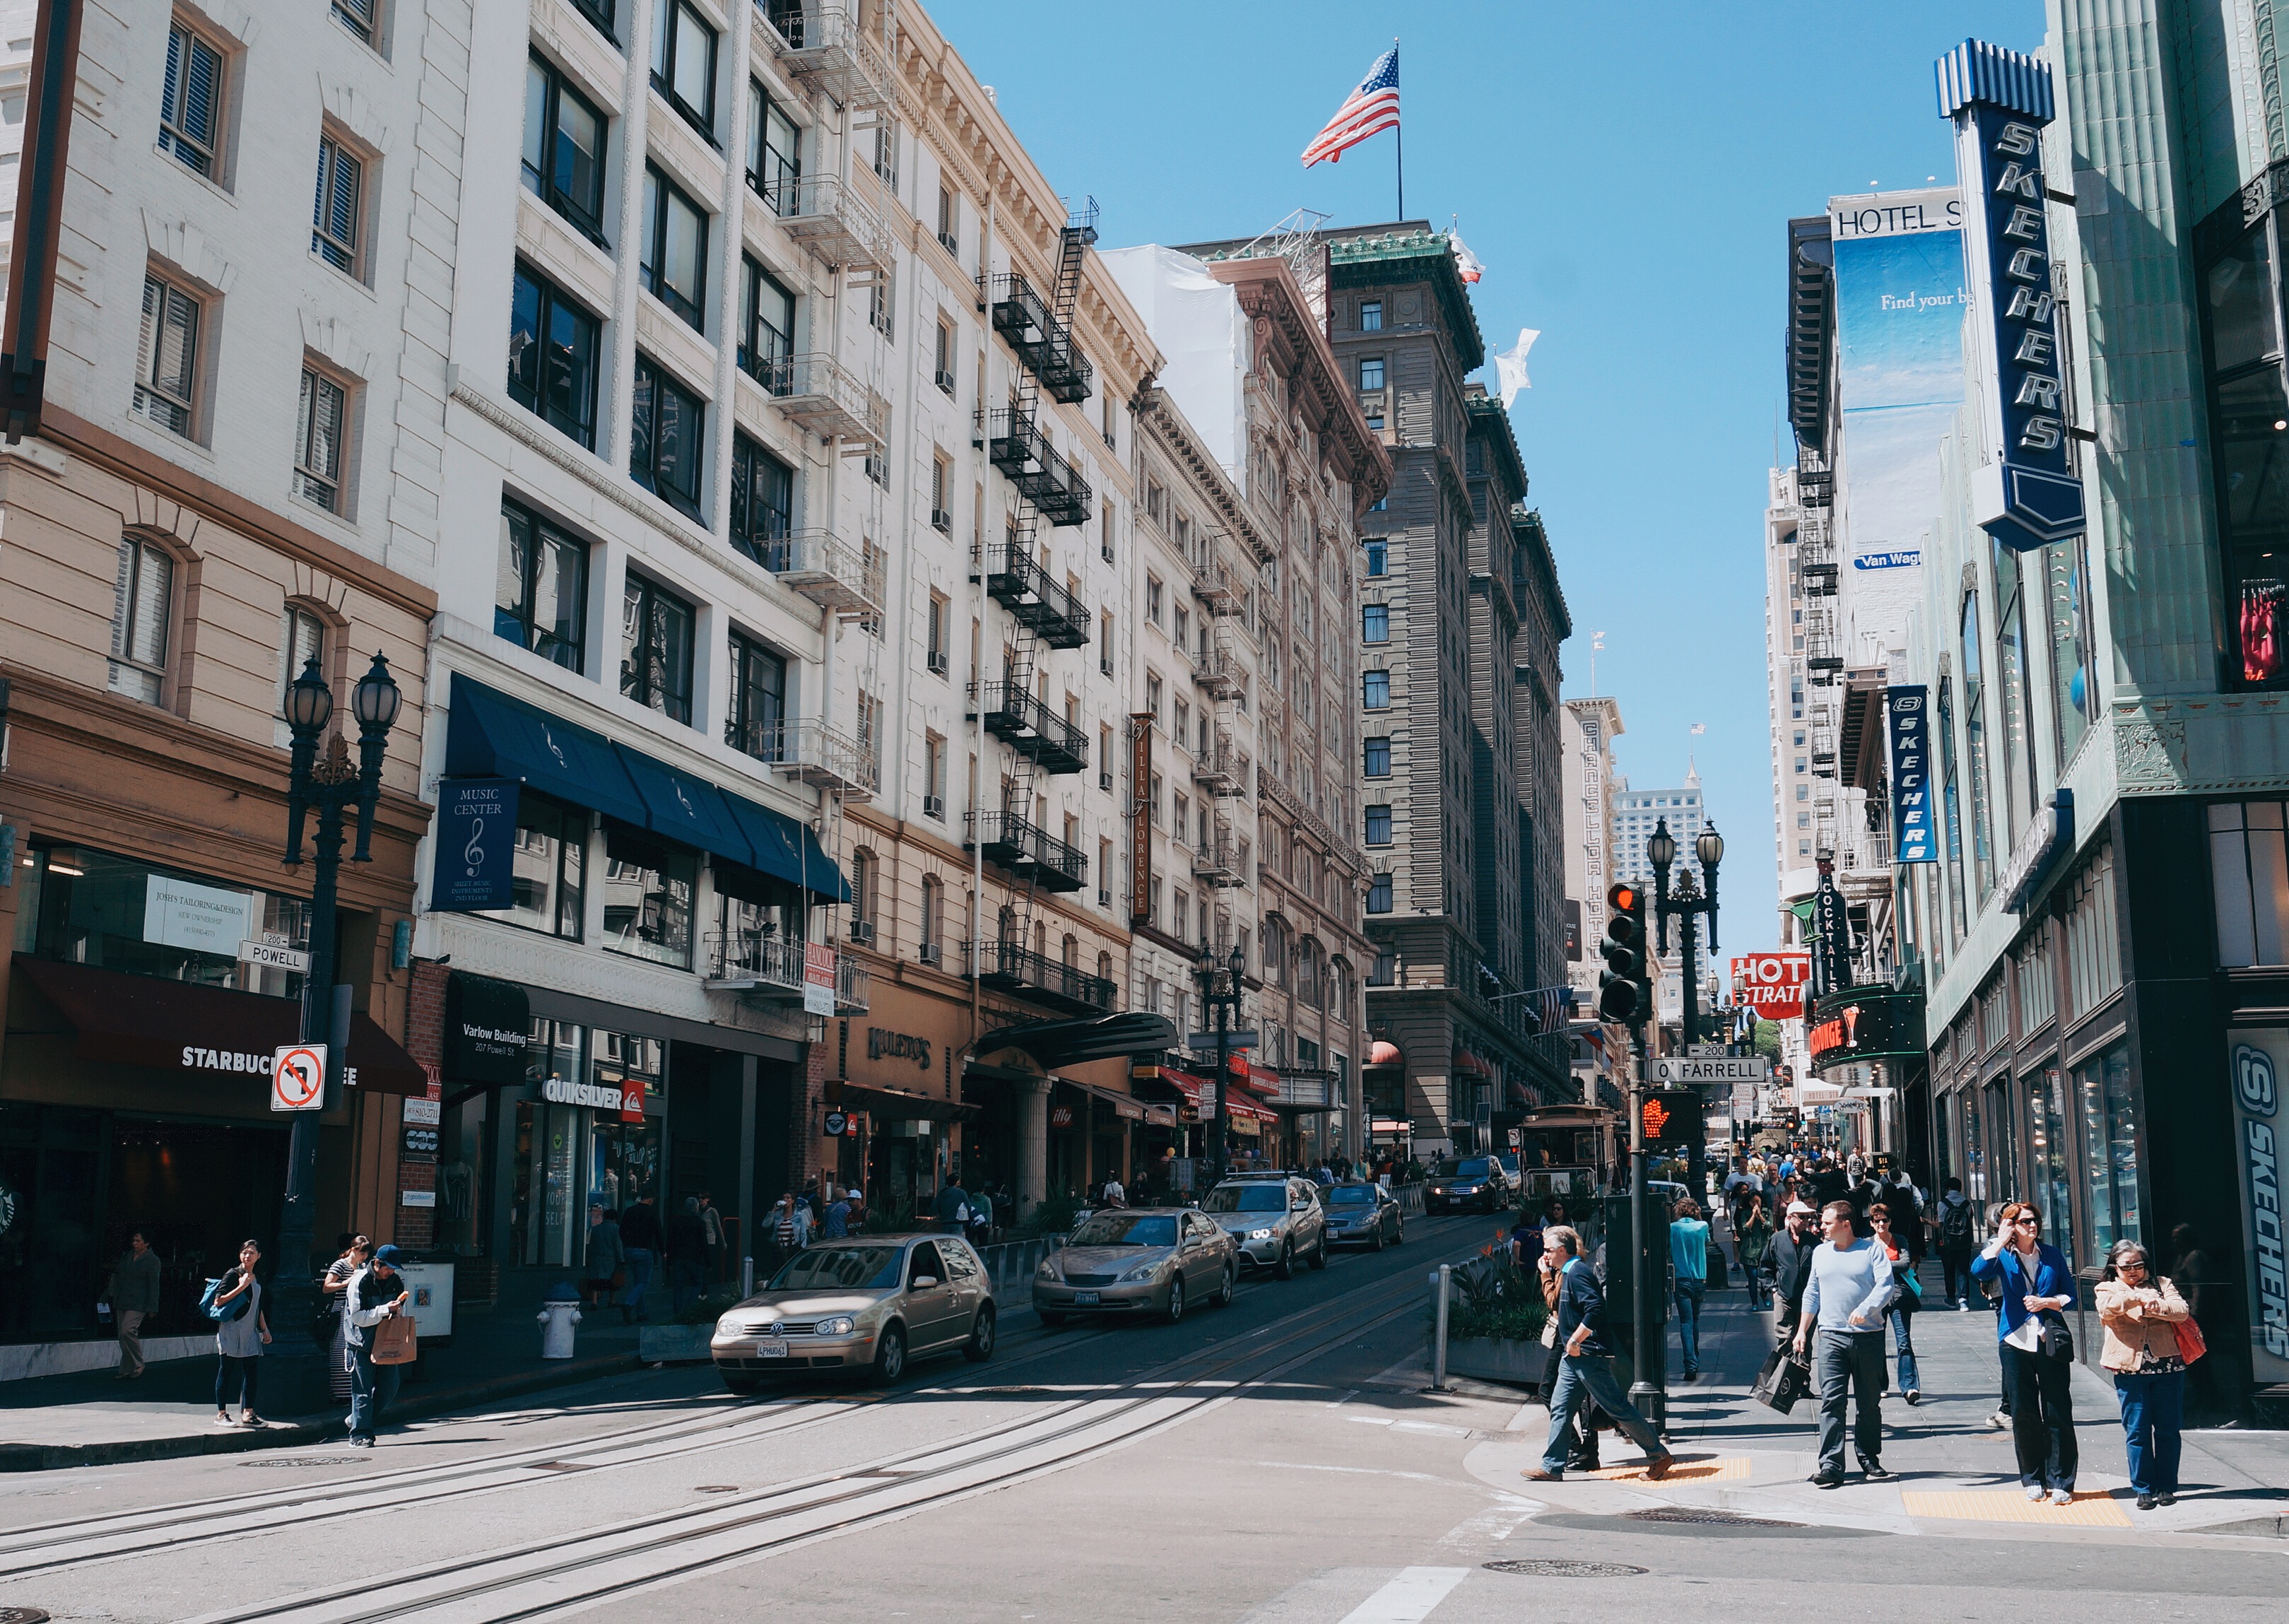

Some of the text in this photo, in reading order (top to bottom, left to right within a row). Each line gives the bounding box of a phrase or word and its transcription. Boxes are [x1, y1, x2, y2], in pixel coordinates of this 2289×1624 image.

[1839, 204, 1937, 235] HOTEL
[1993, 121, 2062, 451] SKECHERS
[1881, 291, 1916, 310] Find
[1918, 294, 1955, 312] your
[1861, 555, 1888, 567] Van
[1131, 722, 1152, 796] VILLA
[460, 789, 499, 800] MUSIC
[1898, 717, 1926, 859] SKECHERS
[1583, 722, 1600, 876] CHANCELLOR
[454, 804, 502, 816] CENTER
[1133, 798, 1150, 909] FLORENCE
[155, 891, 244, 916] JOSH'S TAILORING&DESIGN
[192, 913, 223, 926] OWNERSHIP
[1589, 885, 1604, 963] HOTEL
[268, 934, 281, 945] 200
[1822, 883, 1838, 993] COCKTAILS
[252, 947, 300, 967] POWELL
[807, 943, 834, 969] HANCOCK
[807, 972, 832, 988] AVAILABLE
[464, 1023, 526, 1048] Varlow Building
[1809, 1019, 1842, 1057] LOUNGE
[475, 1042, 487, 1053] 207
[487, 1045, 507, 1056] Powell
[868, 1027, 931, 1070] KULETO'S
[1705, 1046, 1724, 1056] 200
[1683, 1062, 1758, 1078] FARRELL
[544, 1078, 623, 1110] QUIKSILVER
[415, 1107, 438, 1119] 810-2711
[1053, 1107, 1071, 1125] illy
[546, 1191, 566, 1206] YOUR
[546, 1212, 565, 1225] SELF
[2249, 1119, 2289, 1359] SKECHERS
[758, 1346, 785, 1357] 4PHU061
